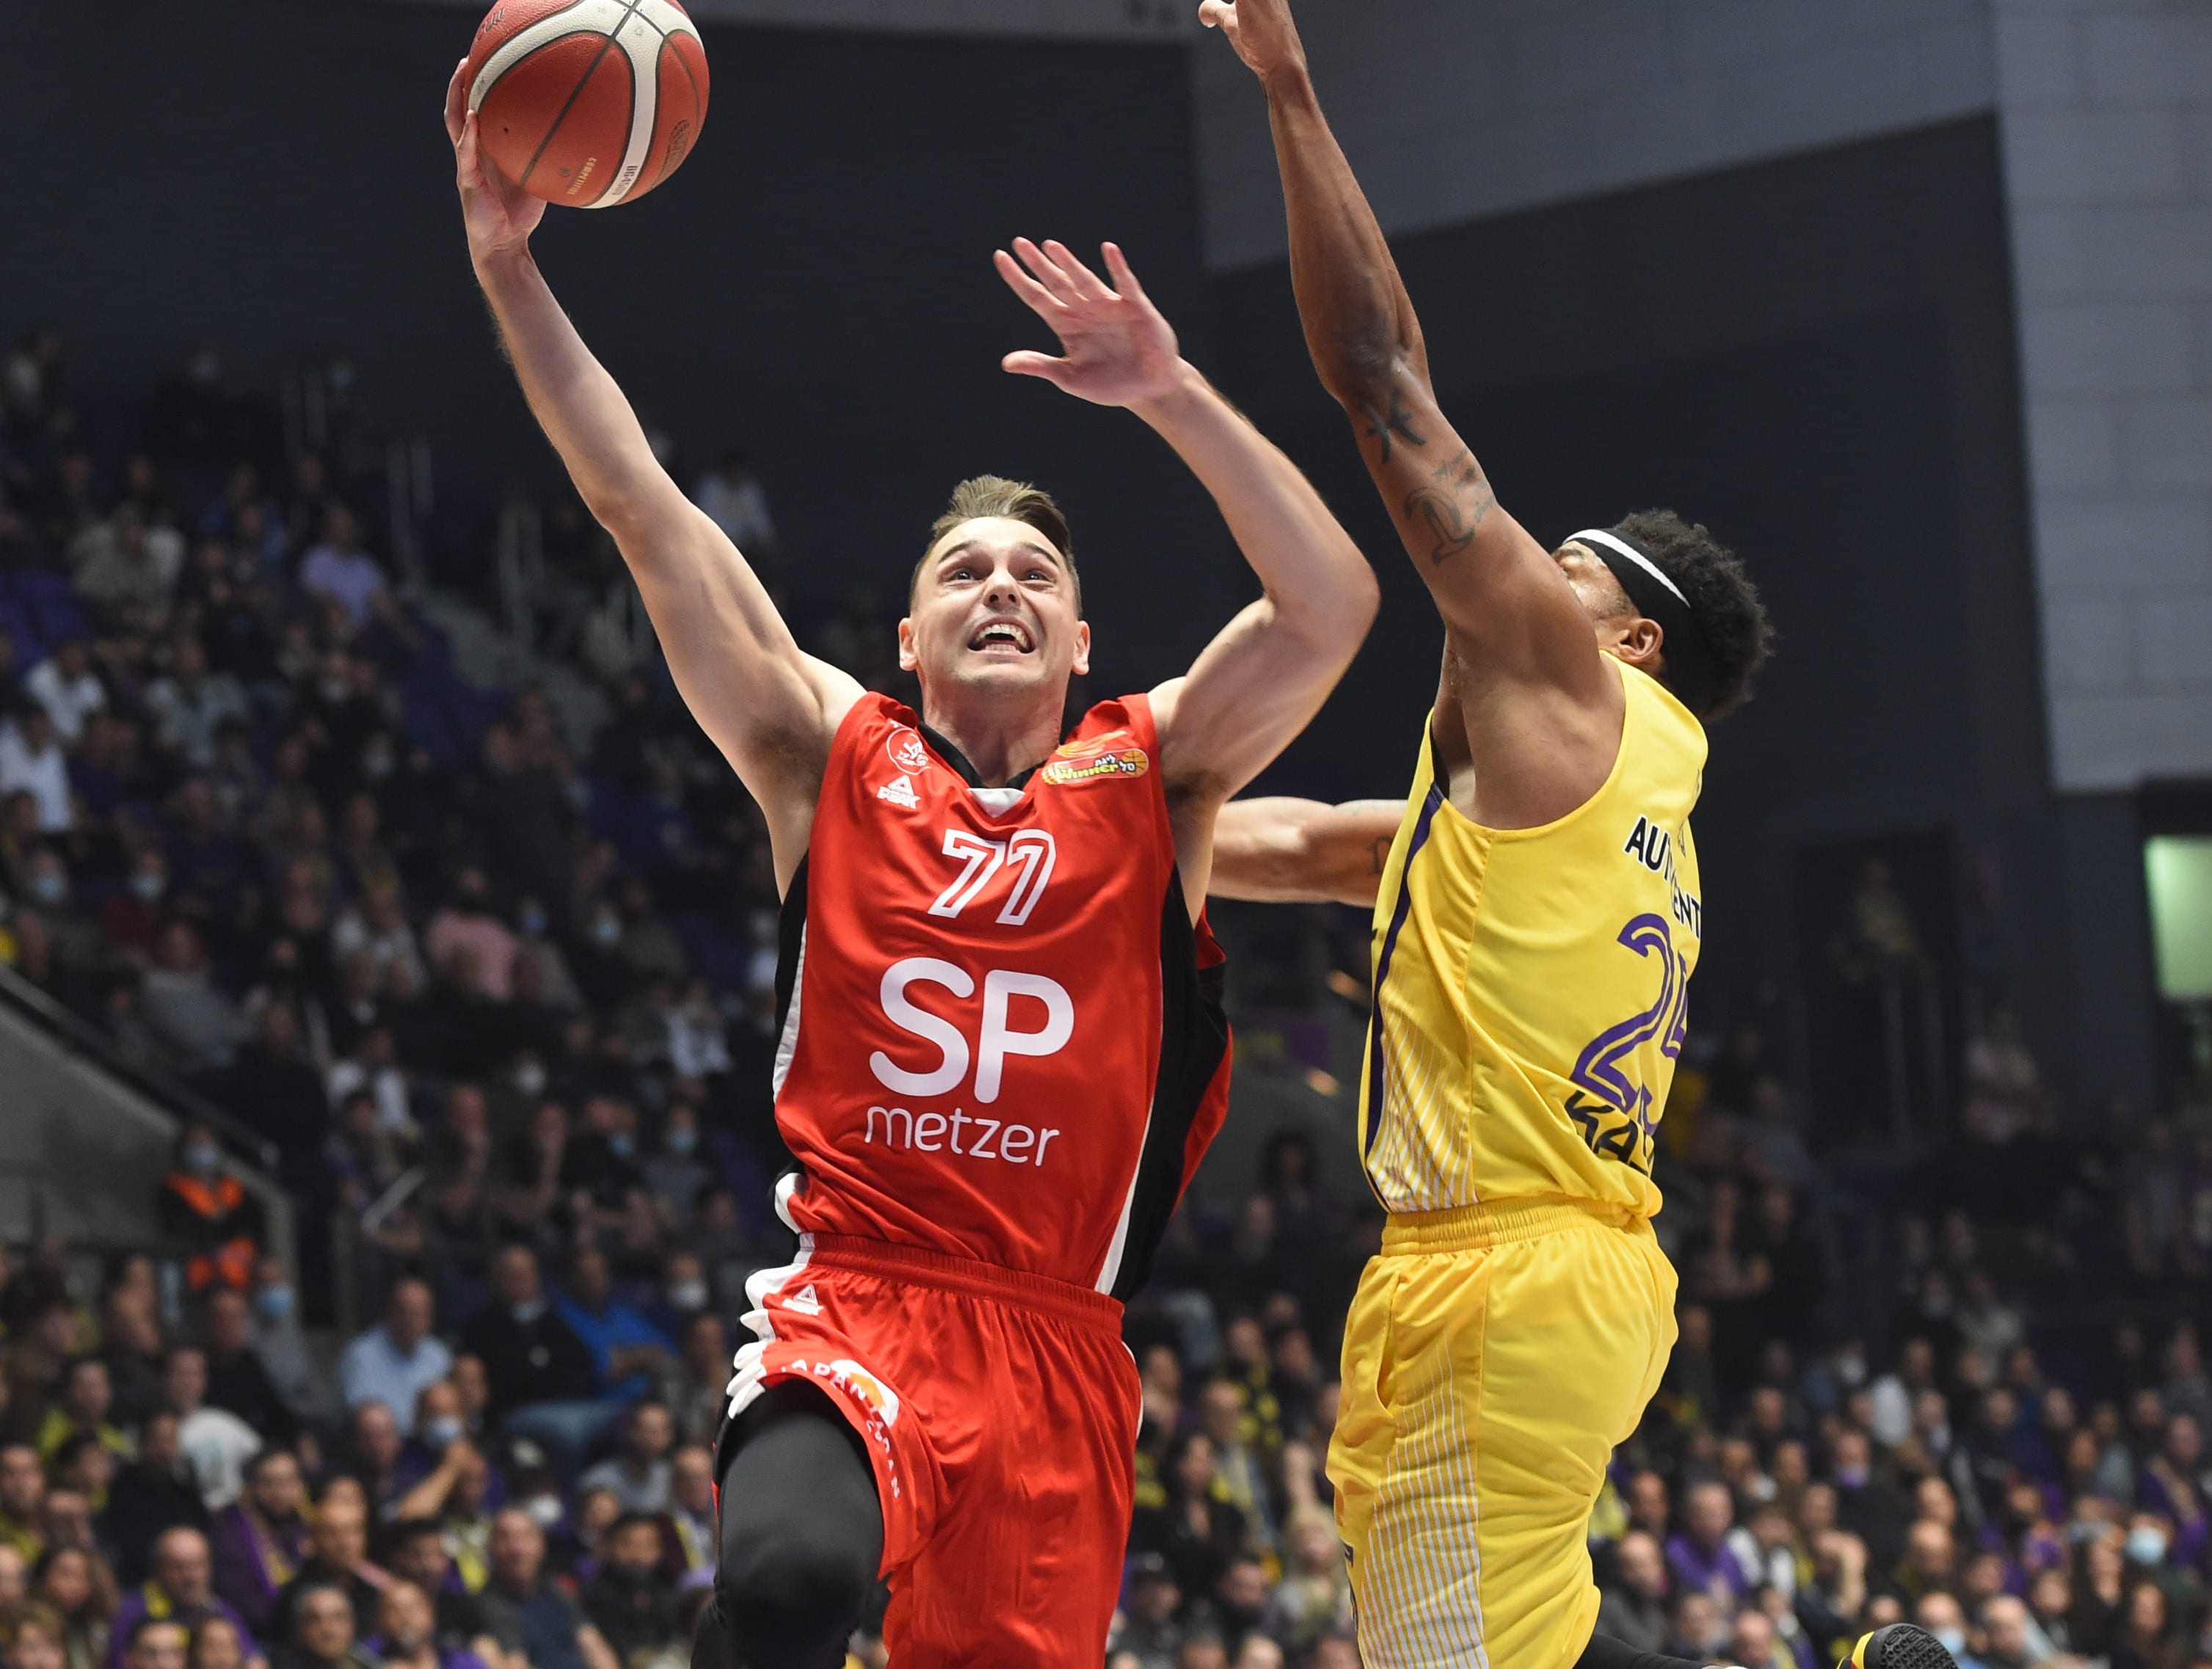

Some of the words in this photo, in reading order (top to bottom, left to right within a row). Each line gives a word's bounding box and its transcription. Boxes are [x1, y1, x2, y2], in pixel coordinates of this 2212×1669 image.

[928, 828, 1057, 926] 77
[869, 956, 1074, 1104] SP
[865, 1106, 1060, 1167] metzer
